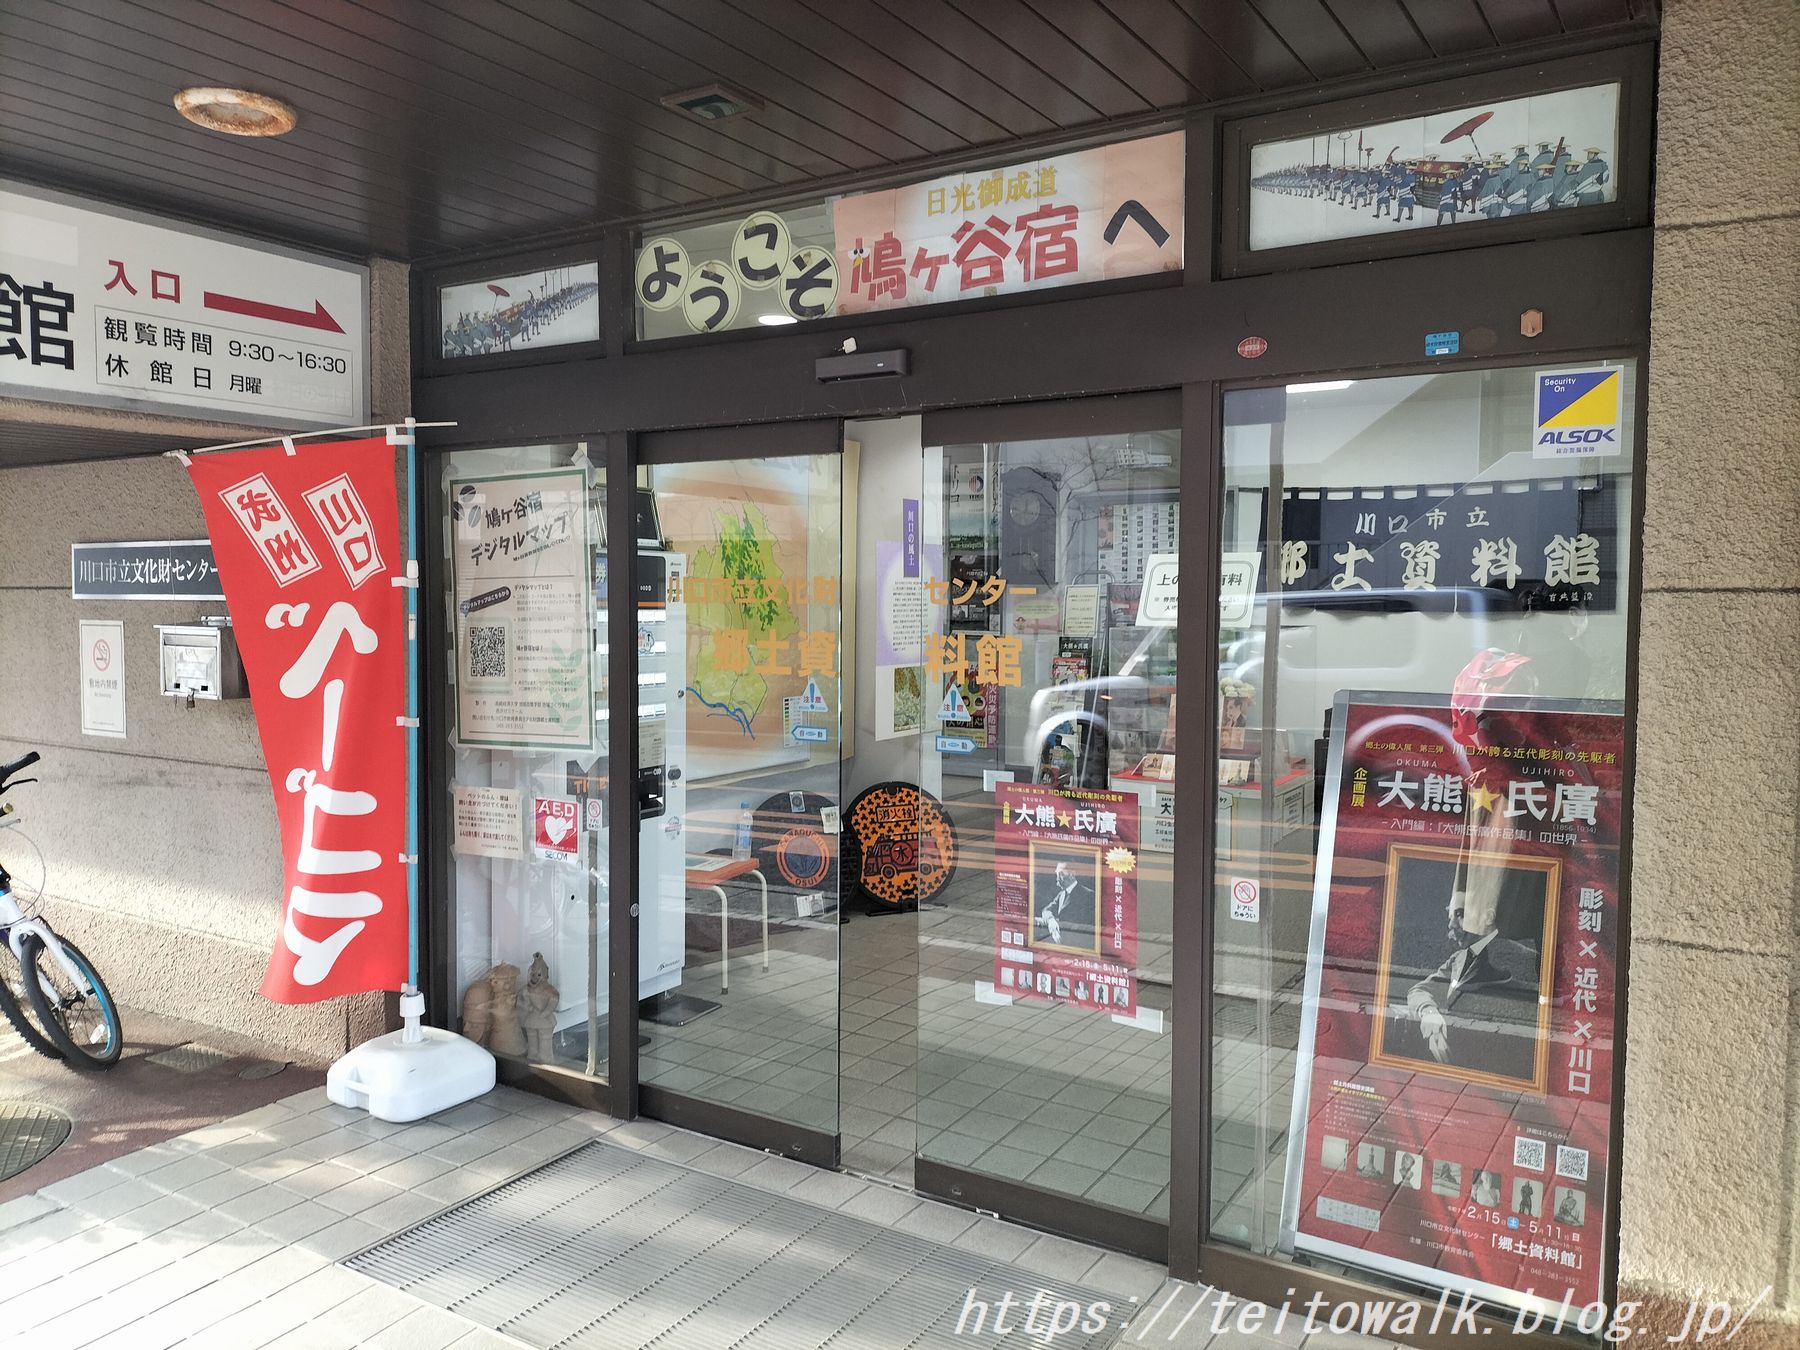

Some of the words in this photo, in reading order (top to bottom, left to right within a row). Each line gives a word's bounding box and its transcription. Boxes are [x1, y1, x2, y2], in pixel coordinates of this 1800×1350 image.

[927, 165, 1059, 217] 日光御成道
[103, 258, 182, 304] 入口
[641, 222, 837, 331] ようこそ
[103, 316, 213, 356] 観覧時間
[105, 353, 212, 391] 休館日
[229, 373, 263, 396] 月曜
[1544, 377, 1577, 386] Security
[1553, 385, 1565, 393] On
[1538, 428, 1616, 446] ALSOK
[1354, 505, 1490, 537] 川口市立
[471, 510, 569, 567] デジタルマップ
[906, 510, 916, 567] 川口の風土
[79, 557, 219, 584] 川口市立文化財センター
[924, 576, 1038, 607] センター
[924, 632, 1024, 688] 料館
[1365, 741, 1413, 754] 郷土の偉人展
[1419, 743, 1444, 754] 第三弾
[1452, 744, 1617, 765] 川口が誇る近代彫刻の先駆者
[1396, 758, 1439, 769] OKUMA
[1522, 766, 1576, 778] UJIHIRO
[1350, 767, 1369, 808] 企画展
[538, 800, 575, 817] AED
[878, 805, 914, 821] 消火栓
[1080, 801, 1106, 809] UJIHIRO
[545, 850, 568, 862] SECOM
[896, 846, 908, 860] 水
[795, 876, 818, 887] OSUI
[1234, 911, 1256, 920] ちゅうい
[1236, 904, 1255, 913] ドアに
